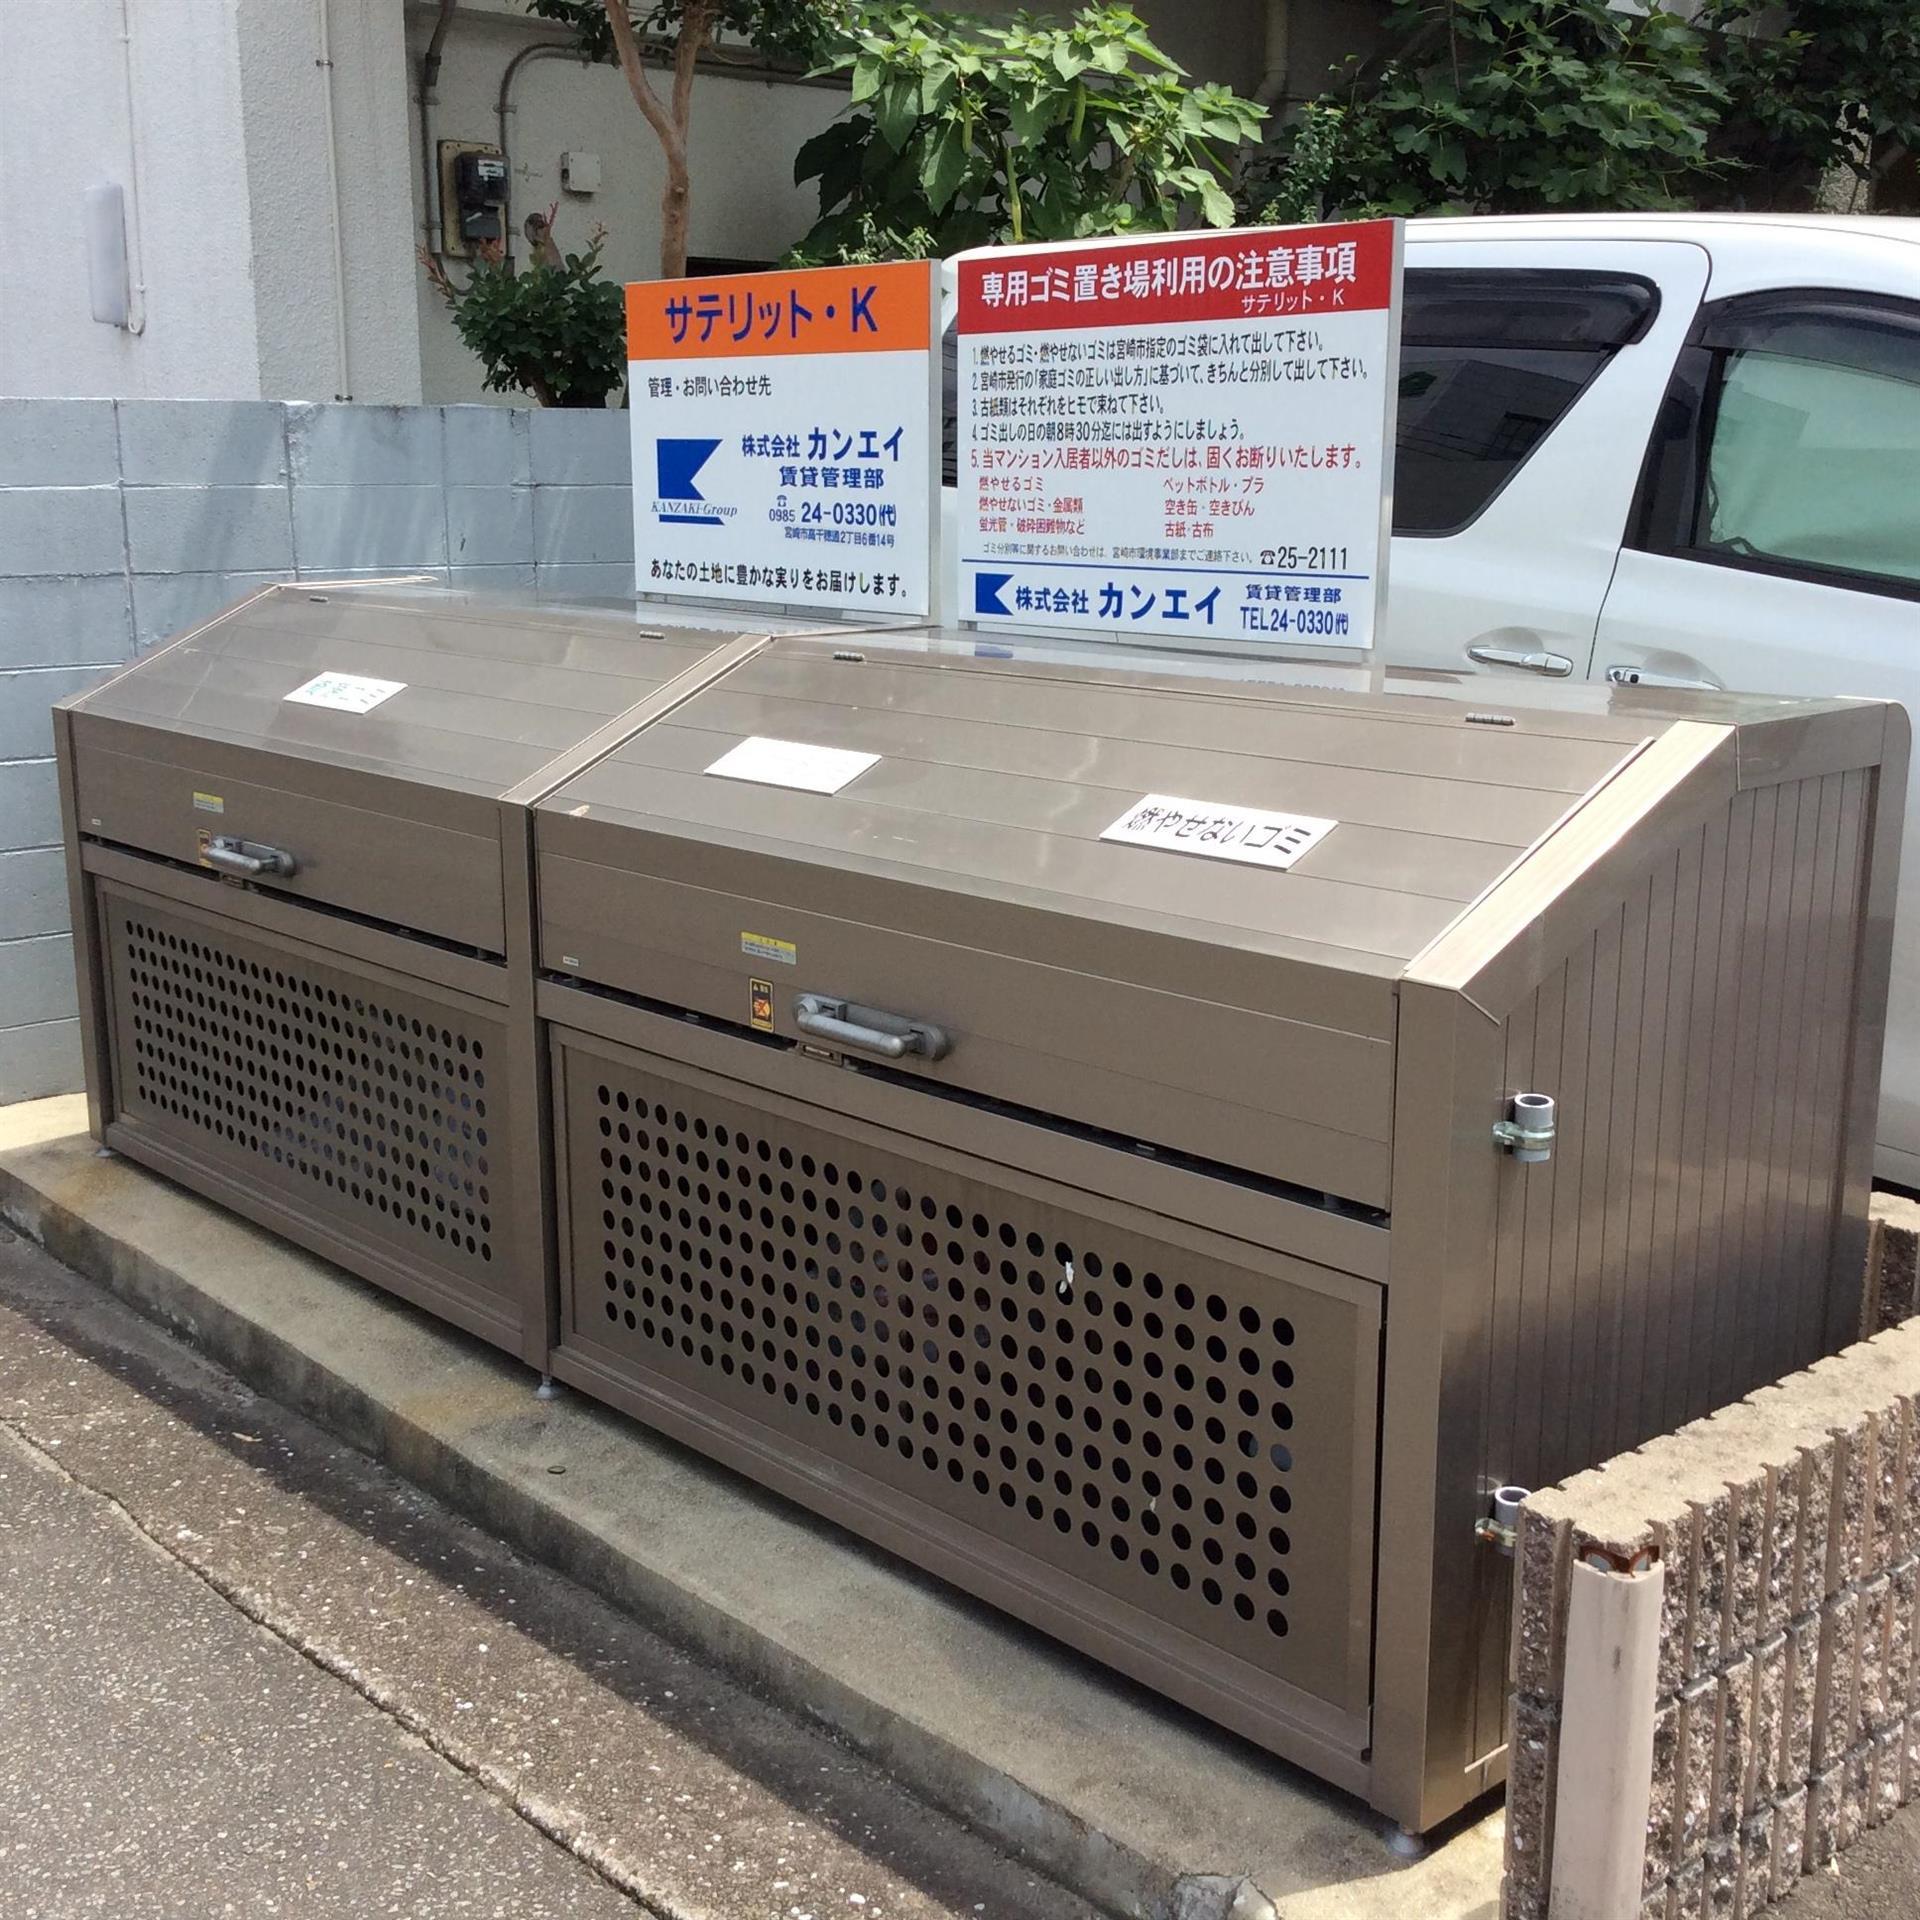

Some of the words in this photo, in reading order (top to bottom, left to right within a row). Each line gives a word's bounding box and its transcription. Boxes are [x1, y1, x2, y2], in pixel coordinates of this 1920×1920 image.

[980, 241, 1358, 308] 専用ゴミ置き場利用の注意事項
[648, 374, 772, 398] 管理・お問い合わせ先
[742, 432, 801, 459] 株式会社
[807, 426, 905, 463] カンエイ
[778, 465, 885, 490] 賃貸管理部
[978, 475, 1045, 494] 燃やせるゴミ
[768, 509, 796, 523] 0985
[1164, 519, 1215, 539] 古紙・古布
[650, 558, 909, 598] あなたの土地に豊かな実りをお届けします。
[1014, 584, 1090, 615] 株式会社
[1098, 581, 1222, 625] カンエイ
[1245, 583, 1342, 604] 賃貸管理部
[1124, 806, 1311, 854] 燃やせないゴミ
